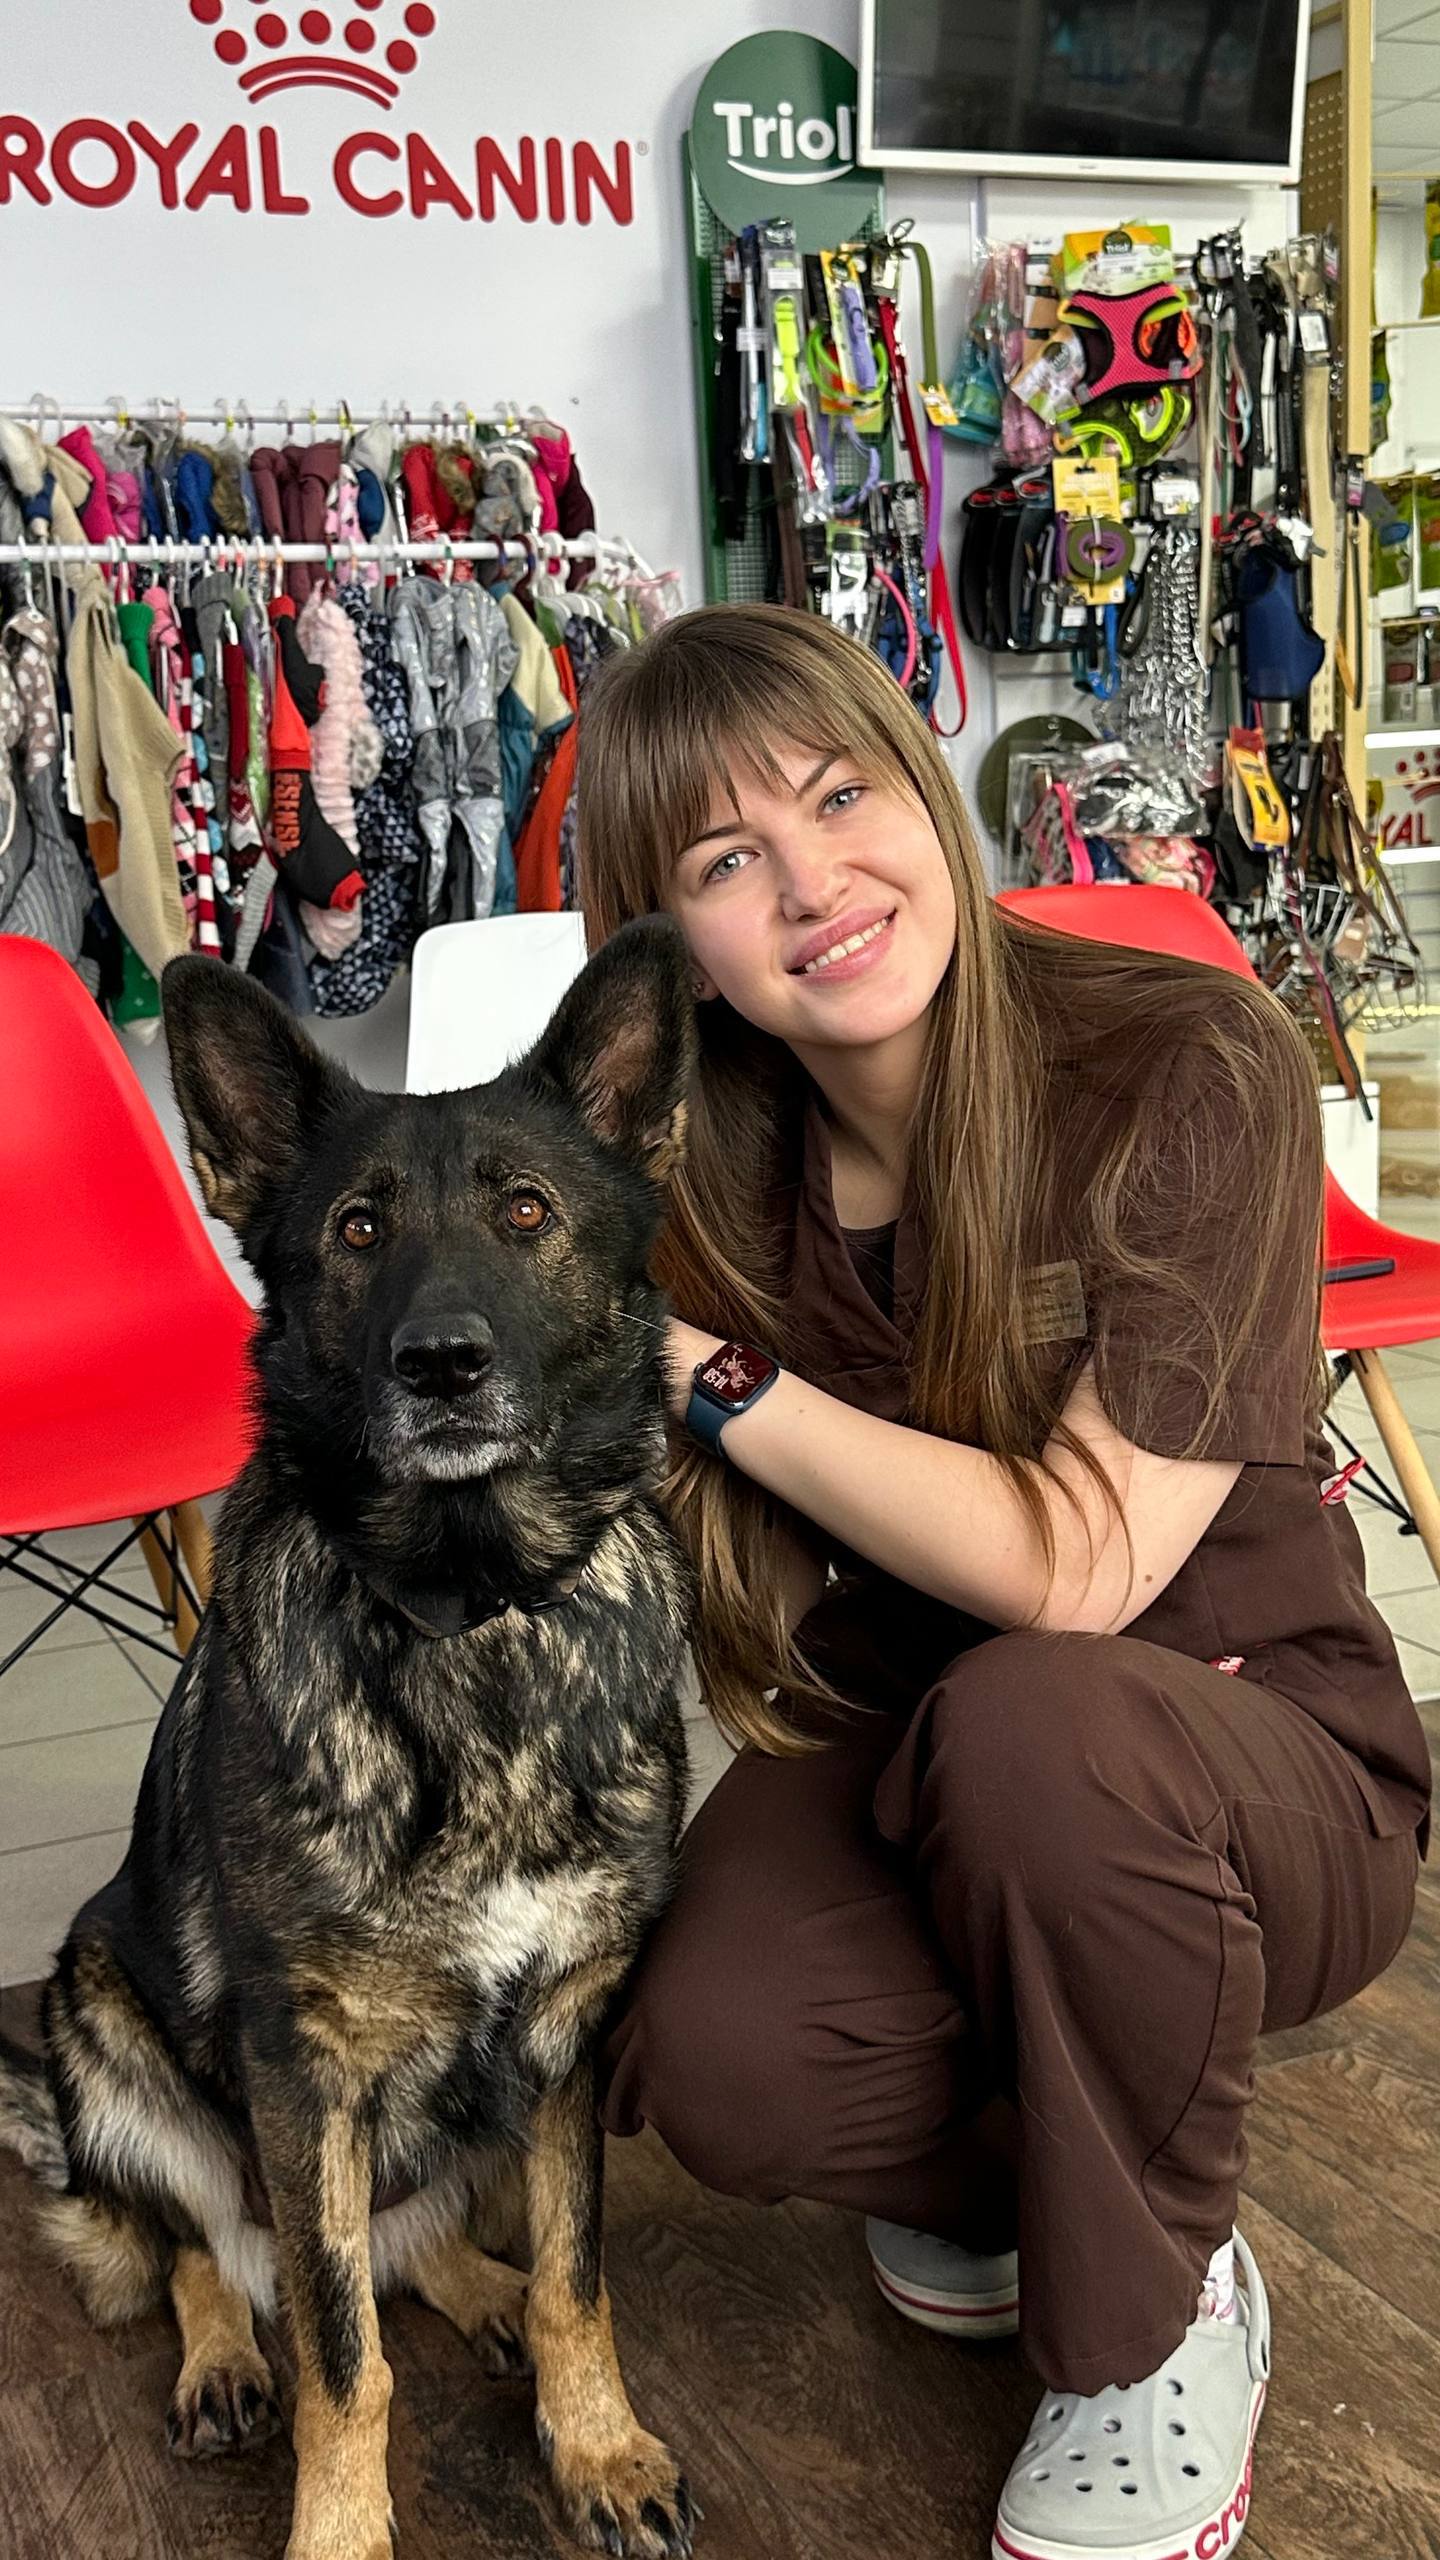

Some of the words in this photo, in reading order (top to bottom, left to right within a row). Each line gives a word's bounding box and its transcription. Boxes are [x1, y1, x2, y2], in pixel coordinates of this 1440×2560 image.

[0, 115, 310, 216] ROYAL
[333, 131, 634, 226] CANIN
[713, 101, 852, 161] Triol
[1368, 811, 1433, 848] YAL
[1195, 2446, 1253, 2560] cro
